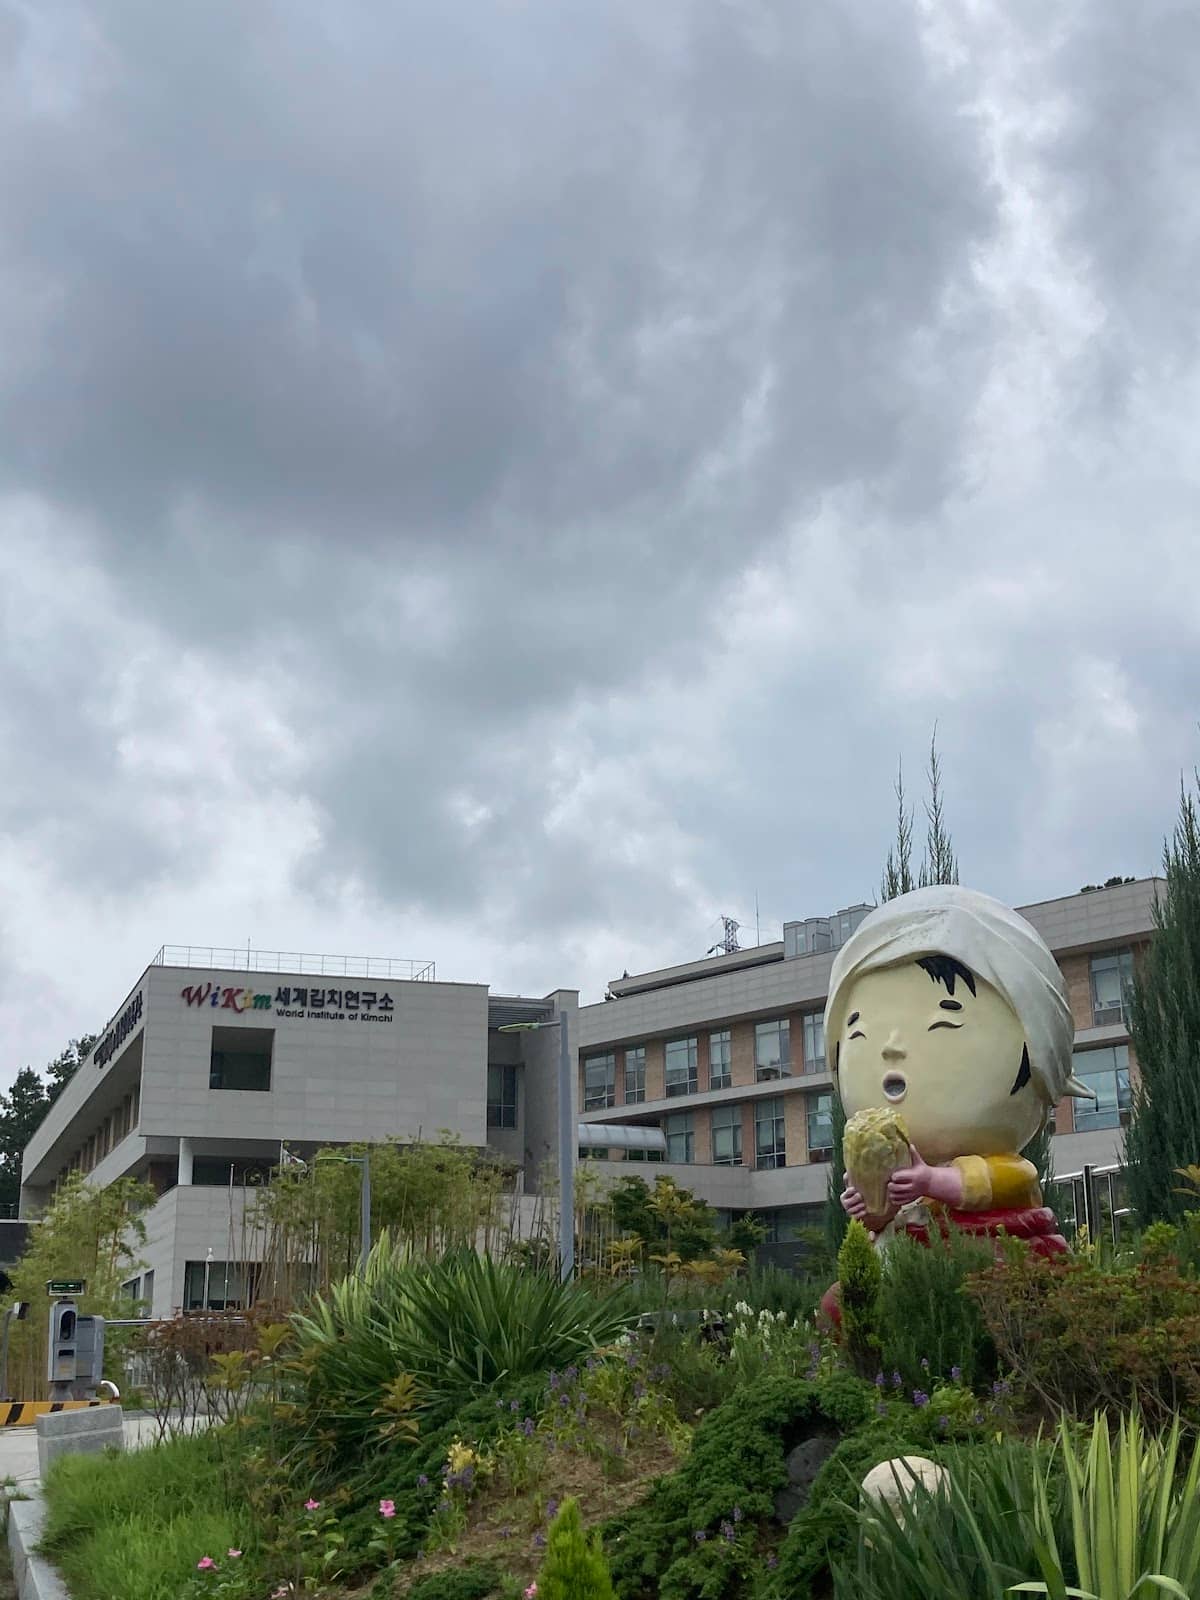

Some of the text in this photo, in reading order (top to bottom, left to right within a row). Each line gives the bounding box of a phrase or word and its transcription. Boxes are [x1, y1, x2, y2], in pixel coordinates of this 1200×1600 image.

[181, 982, 272, 1013] WiKim
[275, 986, 394, 1011] 세계김치연구소
[276, 1008, 393, 1023] World Institute of Kimchi
